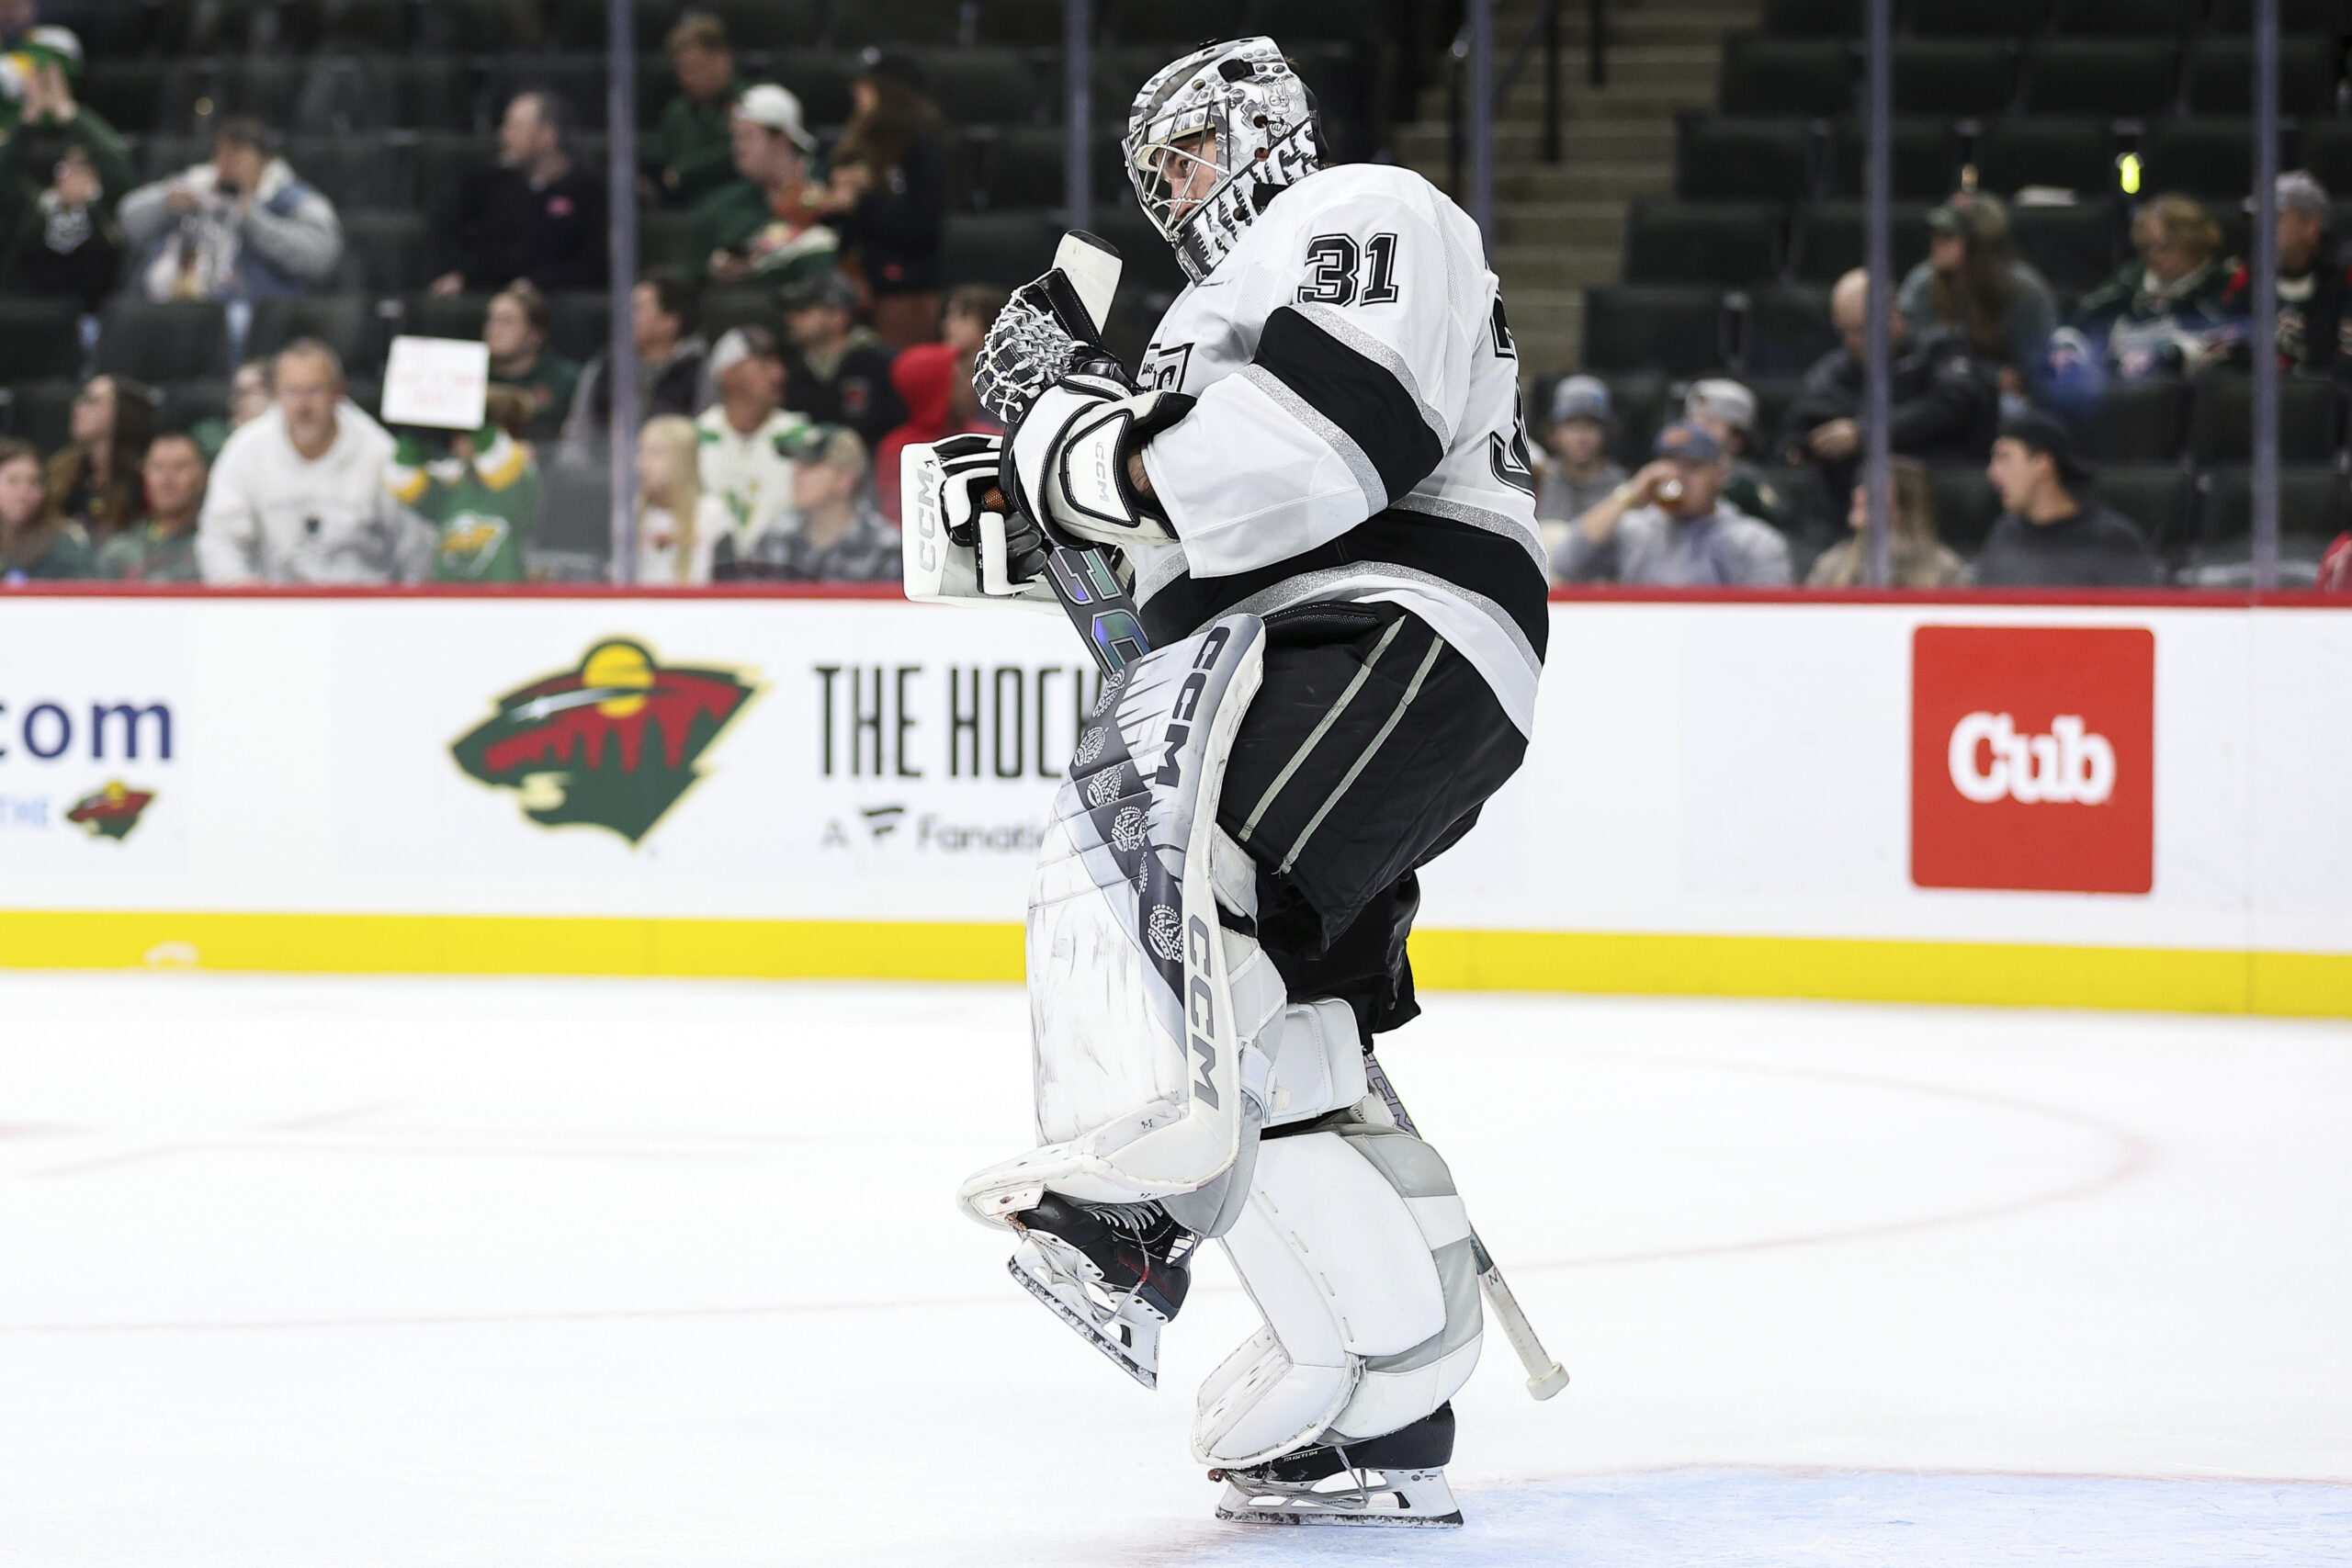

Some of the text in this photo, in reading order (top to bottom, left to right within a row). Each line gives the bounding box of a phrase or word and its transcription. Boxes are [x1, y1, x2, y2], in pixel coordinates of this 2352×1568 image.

[1298, 232, 1399, 307] 31
[918, 469, 936, 573] CCM
[1095, 441, 1110, 502] CCM
[0, 704, 172, 760] om
[813, 666, 922, 777] THE
[1155, 626, 1231, 789] CCM
[1948, 710, 2117, 806] Cub
[1189, 914, 1220, 1111] CCM
